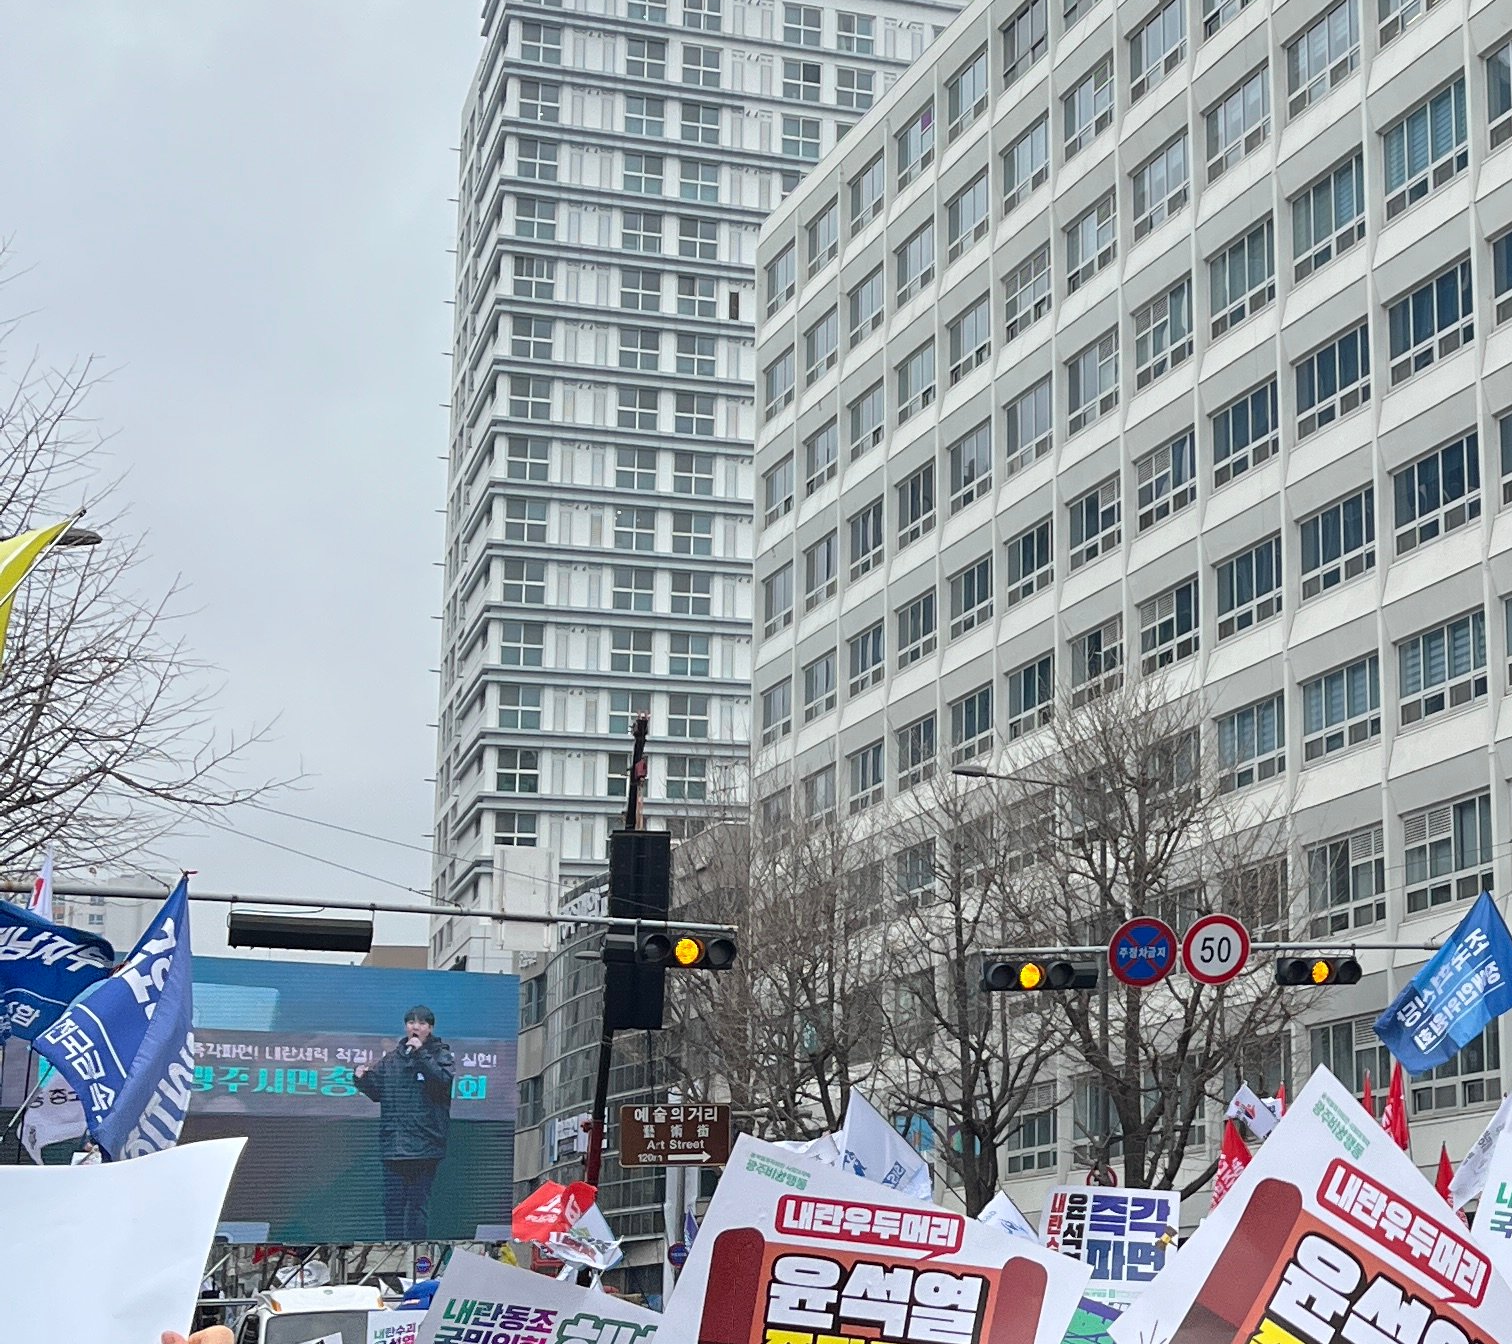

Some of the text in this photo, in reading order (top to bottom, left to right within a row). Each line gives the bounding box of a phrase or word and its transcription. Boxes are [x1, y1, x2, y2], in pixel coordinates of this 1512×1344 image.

[1118, 946, 1166, 960] 주정차금지
[1200, 937, 1231, 963] 50
[633, 1106, 719, 1124] 예술의거리
[637, 1152, 663, 1163] 120m
[646, 1139, 705, 1151] Art Street
[781, 1199, 961, 1248] 내란우두머리
[1089, 1194, 1171, 1237] 즉각
[1323, 1164, 1488, 1300] 내란우두머리
[1086, 1239, 1167, 1282] 파면
[442, 1297, 559, 1334] 내란동조
